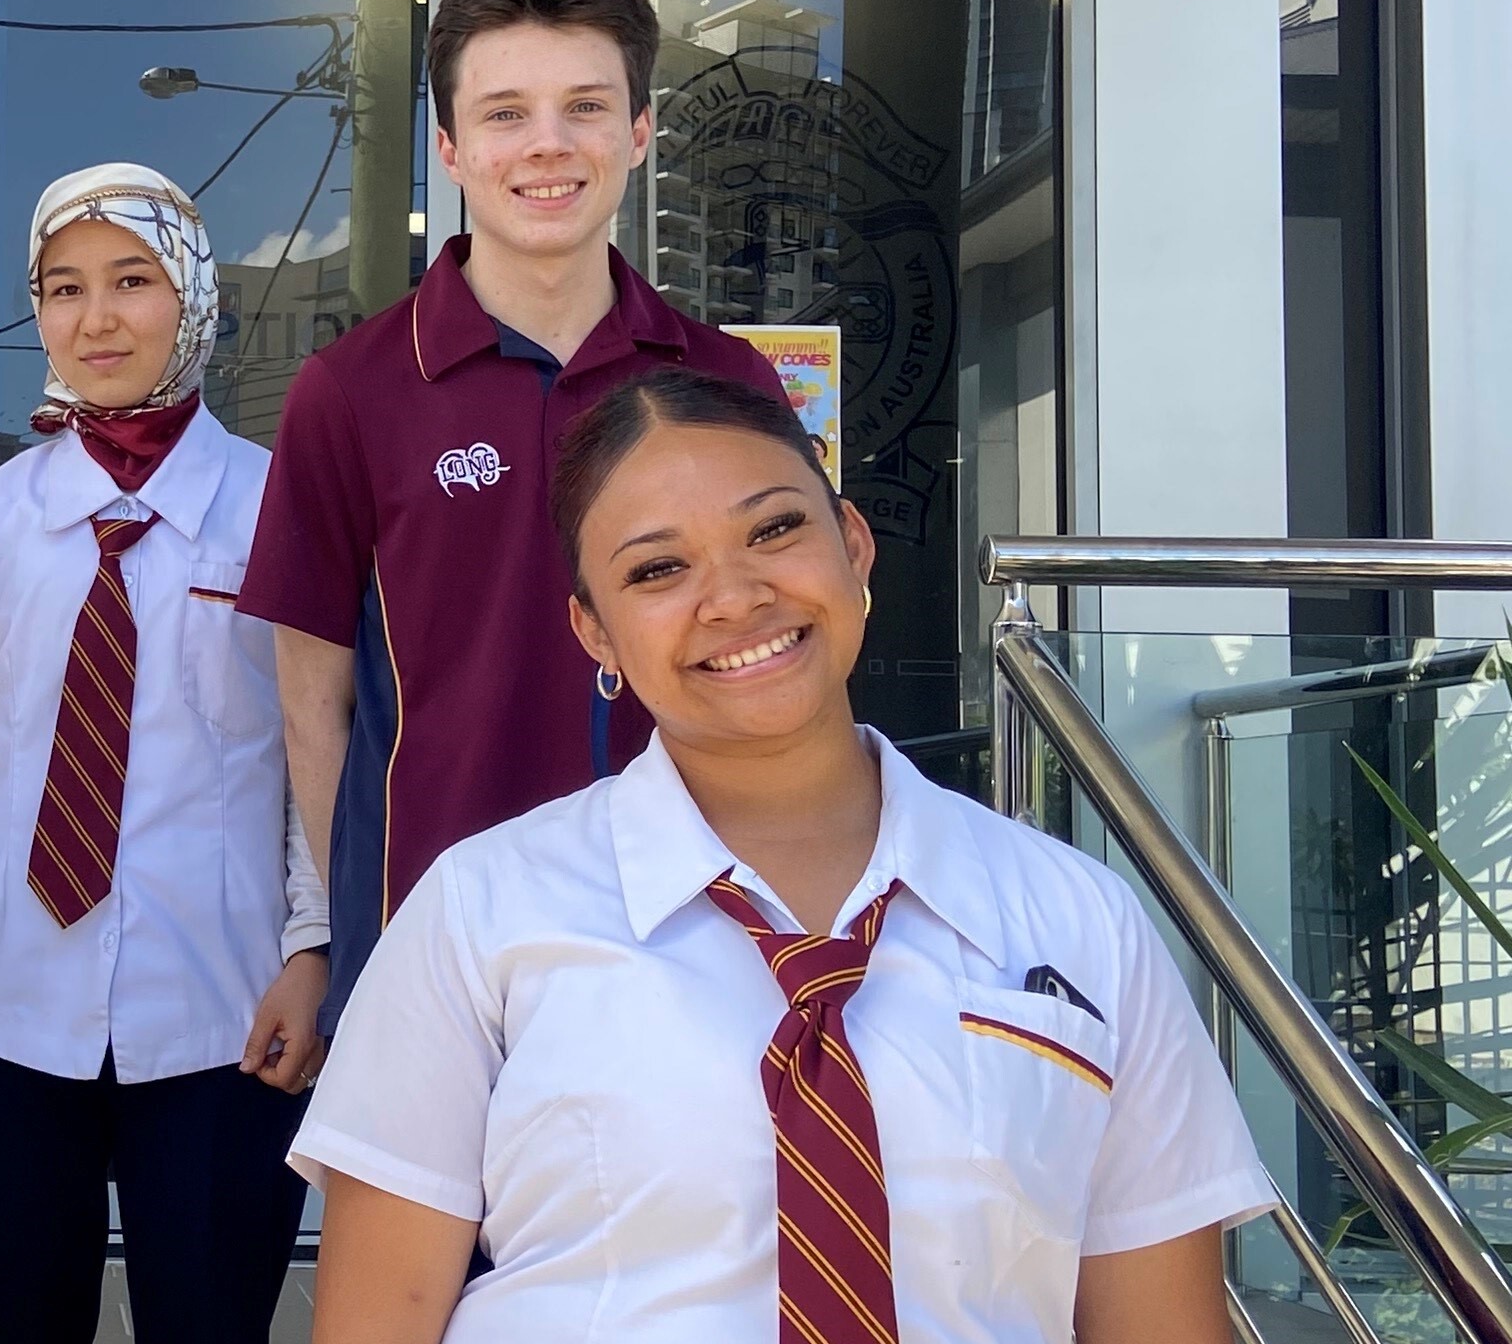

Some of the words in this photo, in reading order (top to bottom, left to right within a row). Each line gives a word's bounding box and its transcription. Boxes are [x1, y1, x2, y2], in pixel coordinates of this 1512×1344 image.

[813, 82, 931, 180] FOREVER
[781, 353, 831, 366] CONES
[880, 252, 935, 419] AUSTRALIA
[439, 453, 496, 483] LONG
